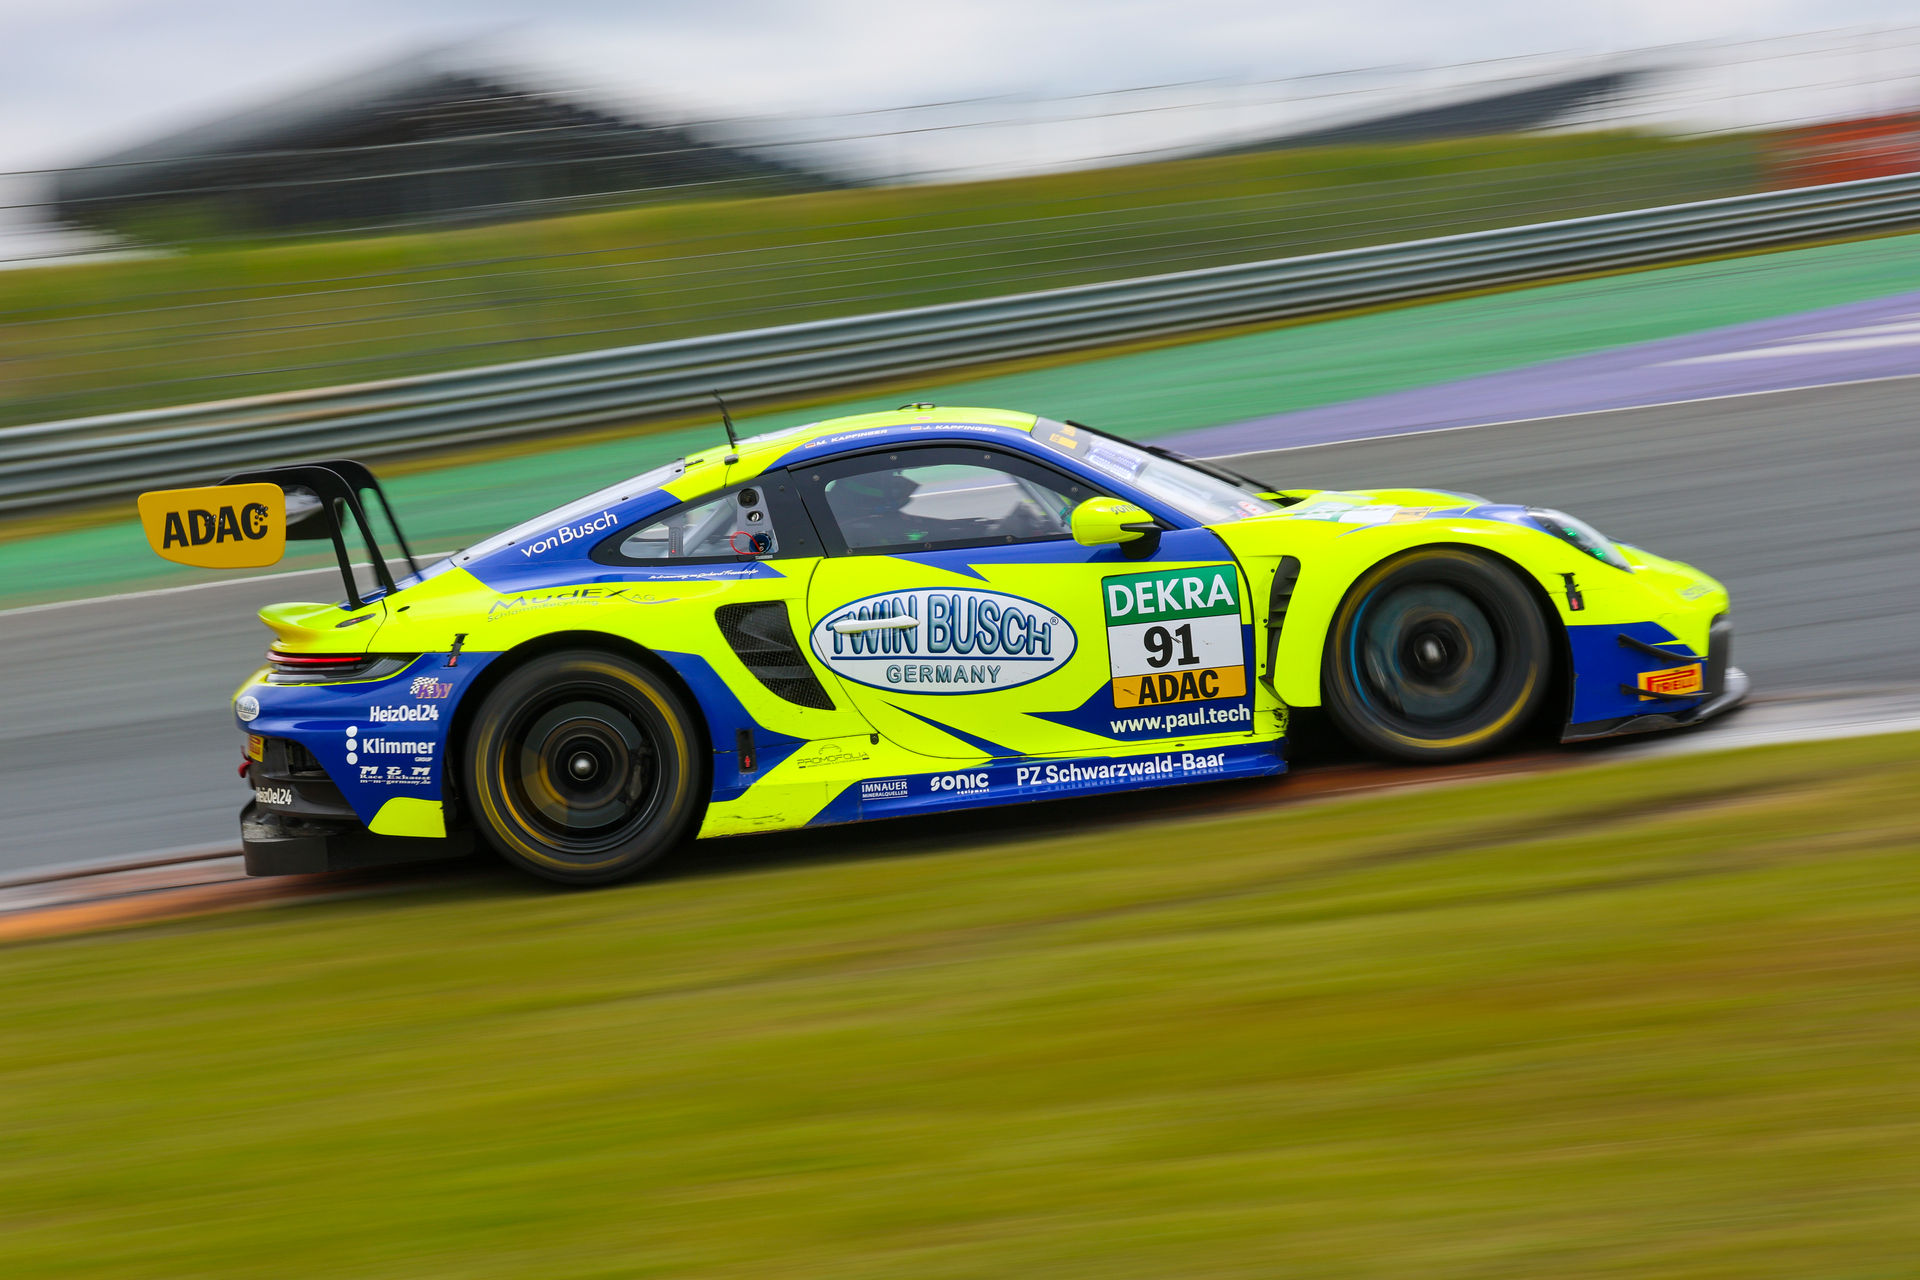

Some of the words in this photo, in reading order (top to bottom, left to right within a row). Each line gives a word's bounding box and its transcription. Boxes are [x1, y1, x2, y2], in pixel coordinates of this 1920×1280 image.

[163, 502, 268, 549] ADAC
[1107, 573, 1235, 617] DEKRA
[826, 595, 918, 654] TWIN
[927, 594, 1052, 655] BUSCH
[1143, 623, 1200, 668] 91
[886, 665, 1001, 684] GERMANY
[1138, 669, 1220, 705] ADAC
[416, 683, 454, 699] KW
[1110, 703, 1251, 733] www.paul.tech
[362, 738, 436, 754] Klimmer
[359, 766, 379, 775] M
[386, 766, 402, 775] &
[411, 767, 431, 776] M
[1016, 766, 1043, 786] PZ
[1045, 753, 1225, 784] Schwarzwald-Baar
[861, 781, 908, 793] IMNAUER
